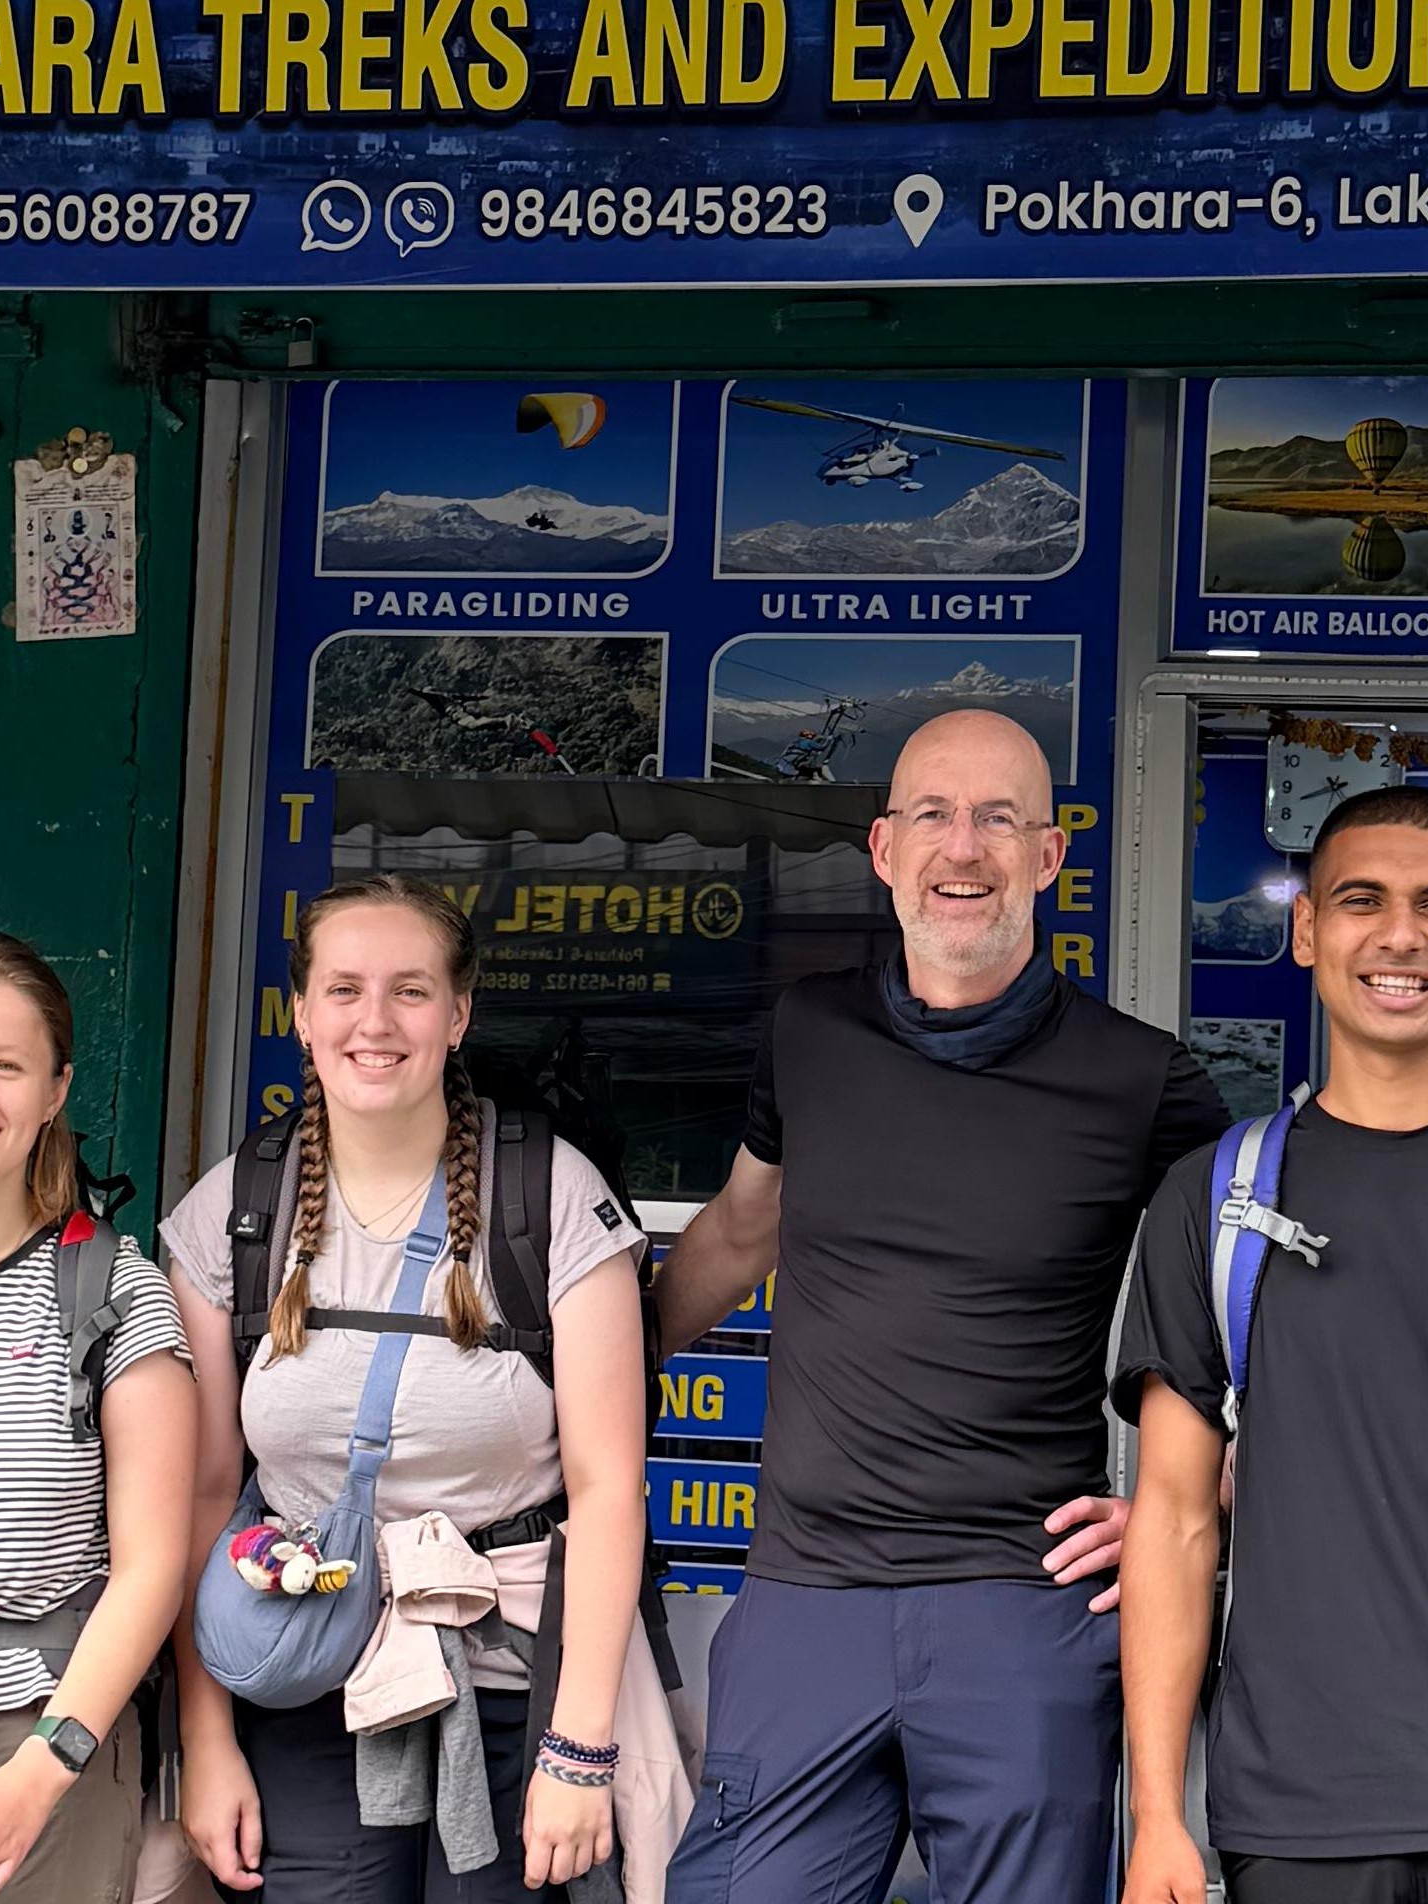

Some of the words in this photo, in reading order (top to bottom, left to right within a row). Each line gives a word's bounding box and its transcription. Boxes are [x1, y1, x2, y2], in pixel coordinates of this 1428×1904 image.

[479, 184, 828, 238] 9846845823
[984, 179, 1317, 239] Pokhara-6,
[351, 590, 630, 620] PARAGLIDING
[761, 593, 891, 621] ULTRA
[909, 594, 1032, 622] LIGHT
[1207, 609, 1266, 636] HOT
[1272, 610, 1319, 637] AIR
[1283, 755, 1300, 768] 10
[1380, 754, 1390, 767] 2
[1283, 780, 1292, 793] 9
[1281, 807, 1292, 820] 8
[1303, 825, 1313, 839] 7
[671, 1480, 755, 1529] HIR
